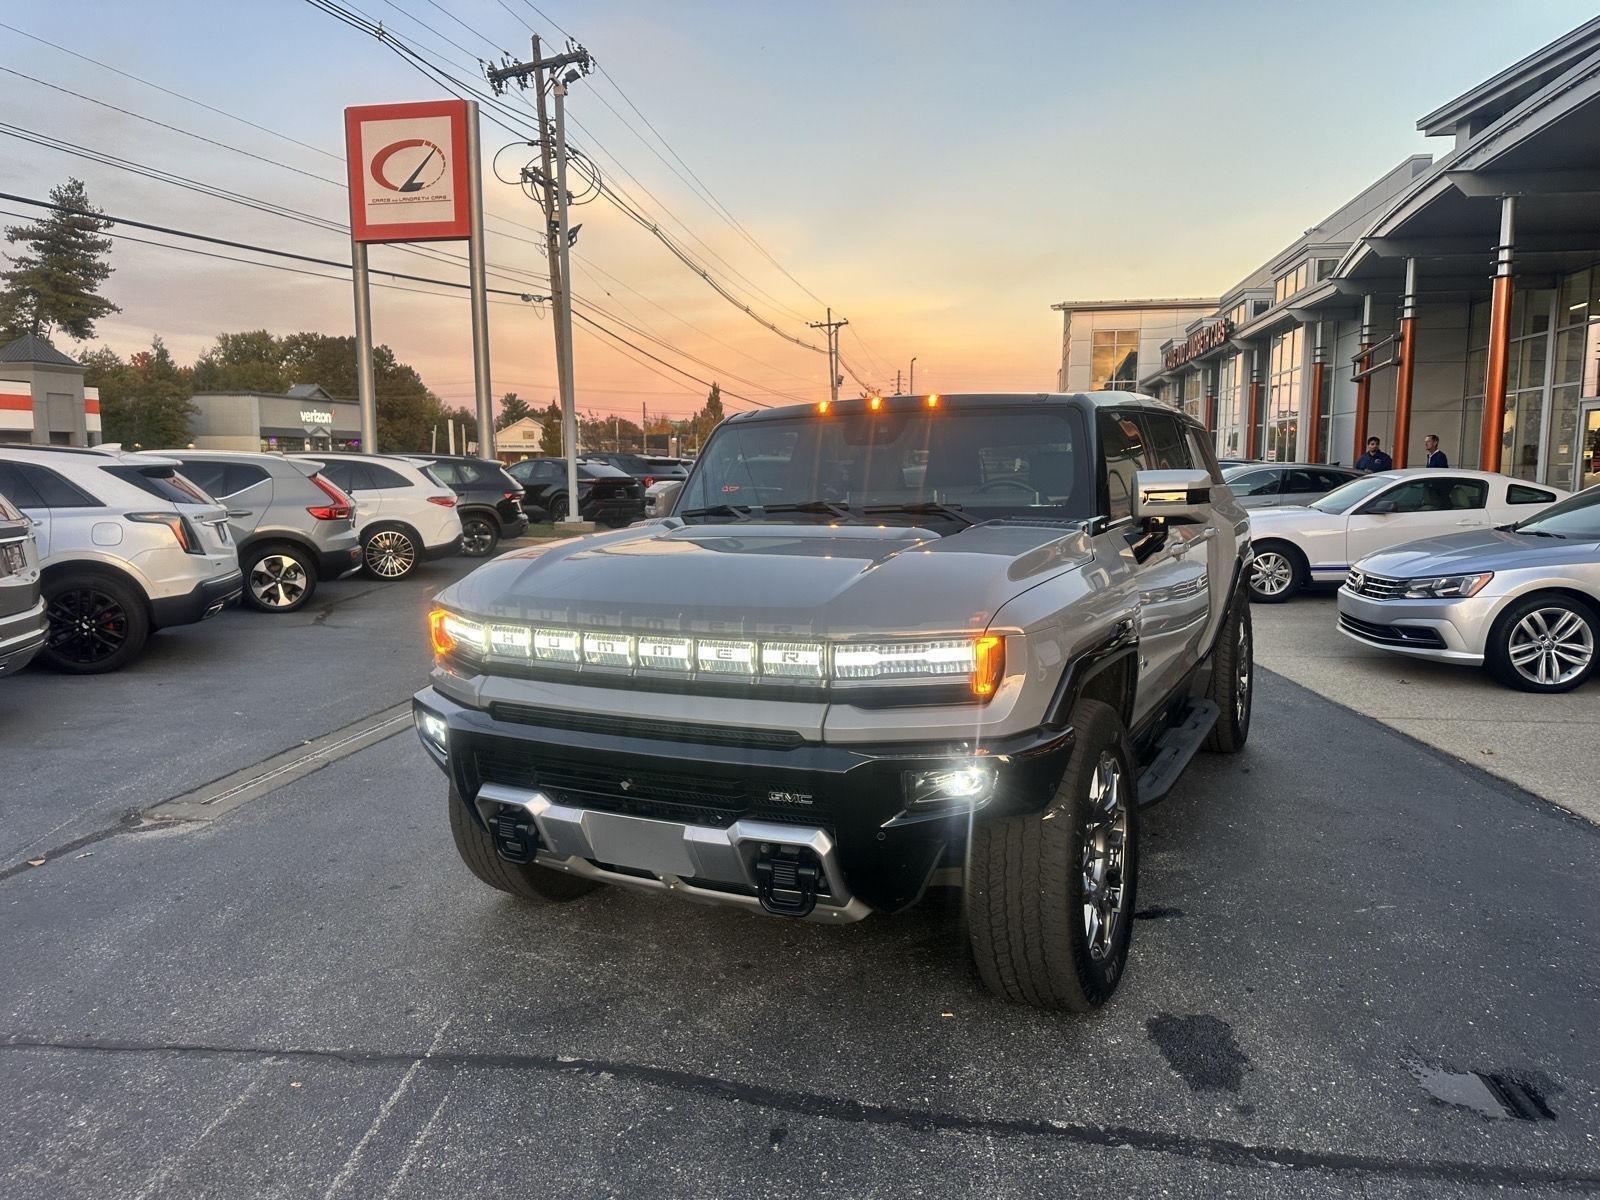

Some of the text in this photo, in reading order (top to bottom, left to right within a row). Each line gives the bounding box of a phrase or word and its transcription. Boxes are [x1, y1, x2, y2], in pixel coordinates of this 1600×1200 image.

[300, 409, 332, 423] verizon
[502, 633, 800, 663] HUMMER
[768, 791, 813, 805] GMC
